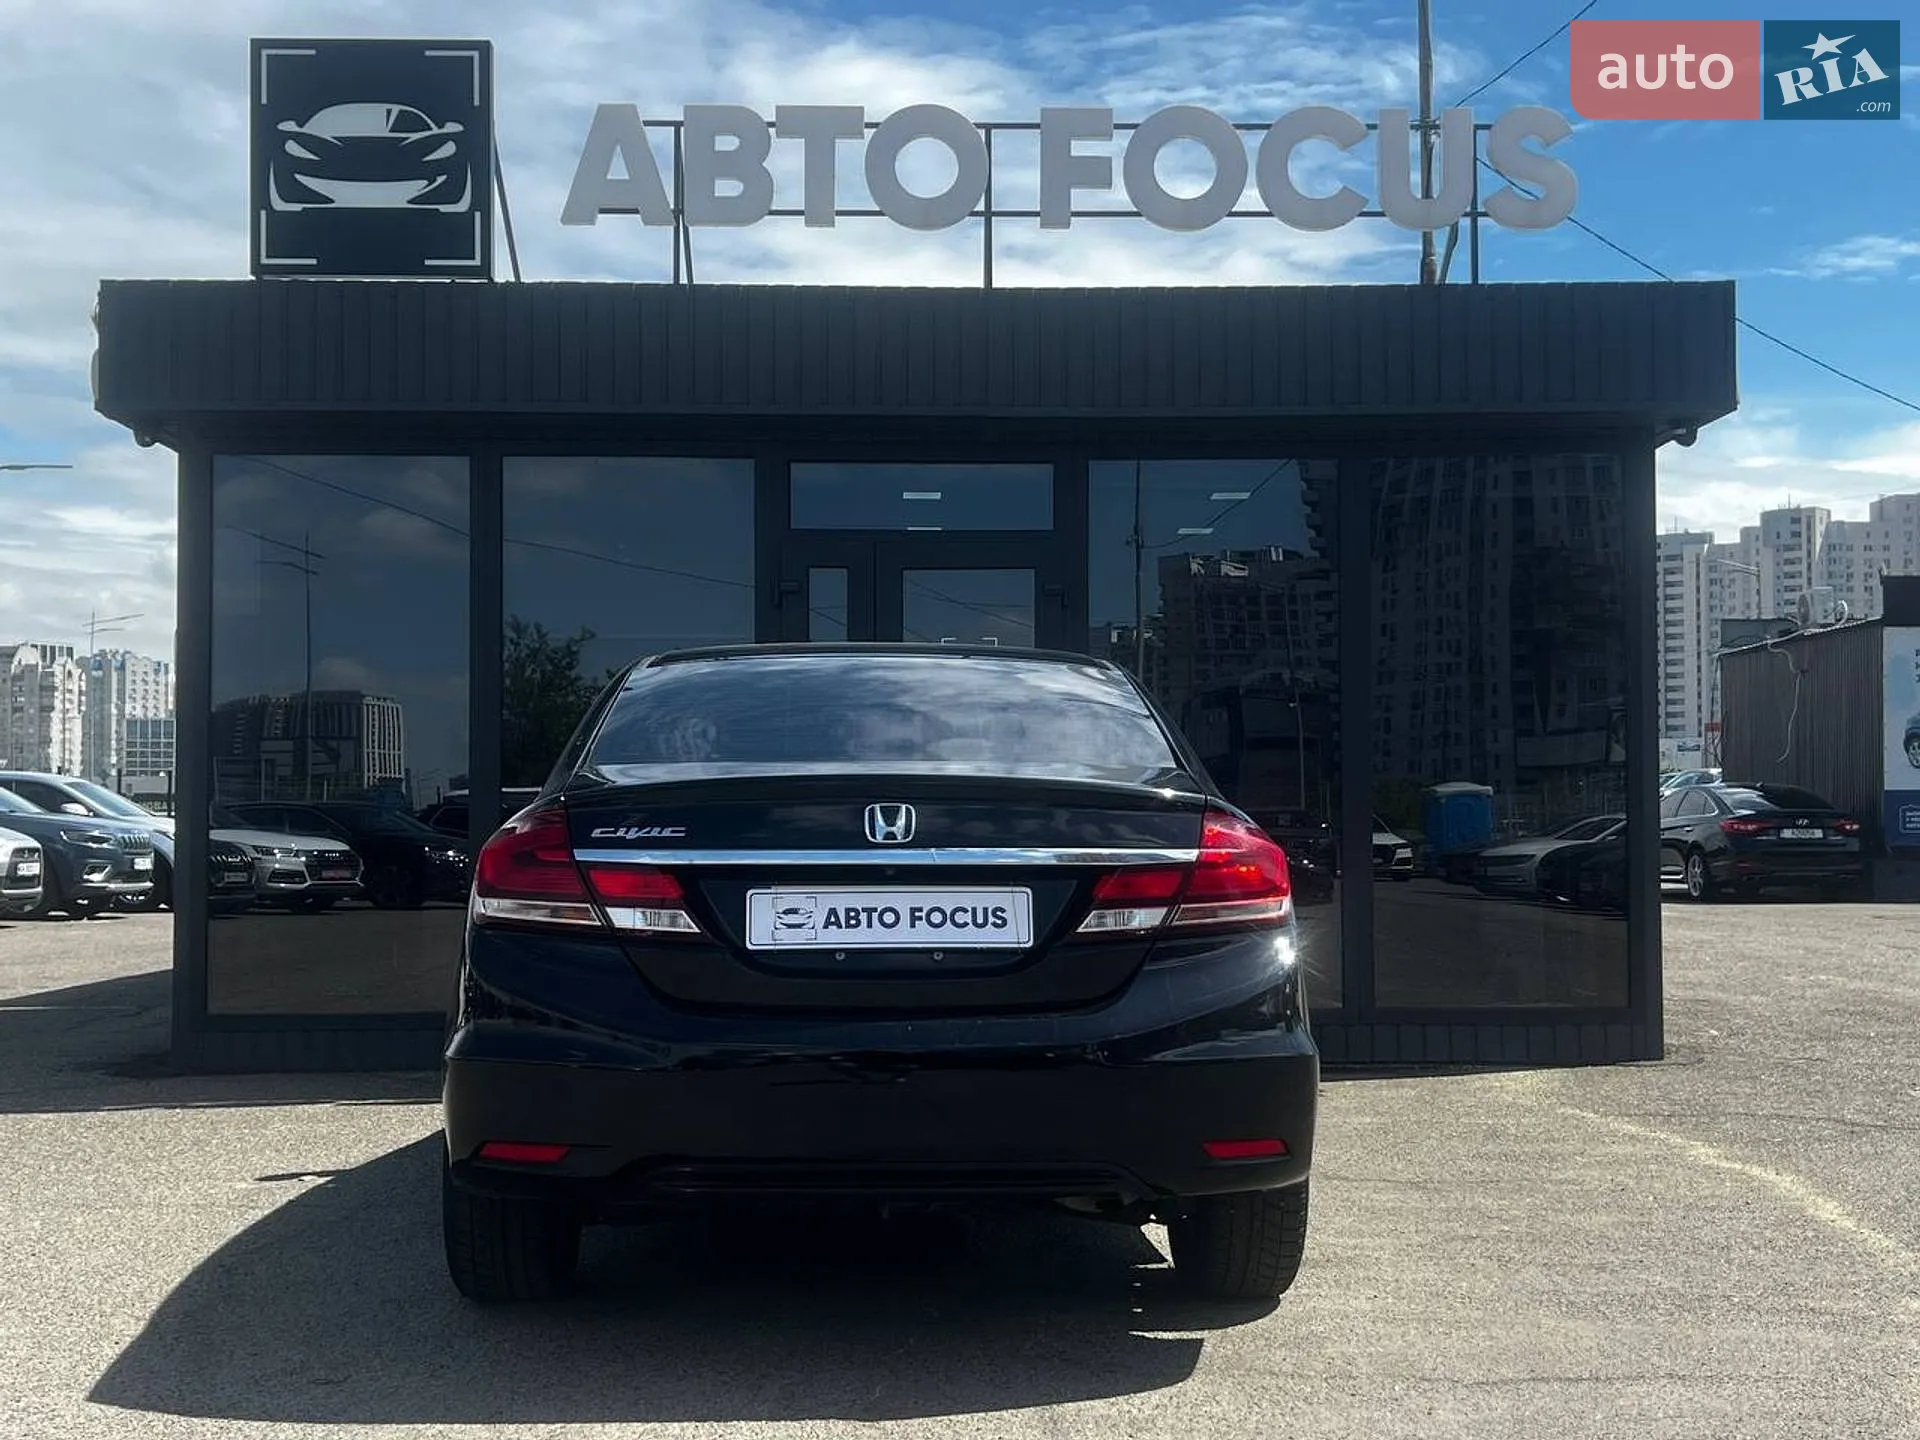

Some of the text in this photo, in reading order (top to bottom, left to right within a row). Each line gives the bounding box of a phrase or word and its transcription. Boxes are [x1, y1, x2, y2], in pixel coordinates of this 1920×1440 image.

[560, 103, 1577, 232] АВТО FOCUS
[590, 826, 687, 840] CIVIC
[822, 906, 1008, 930] АВТО FOCUS
